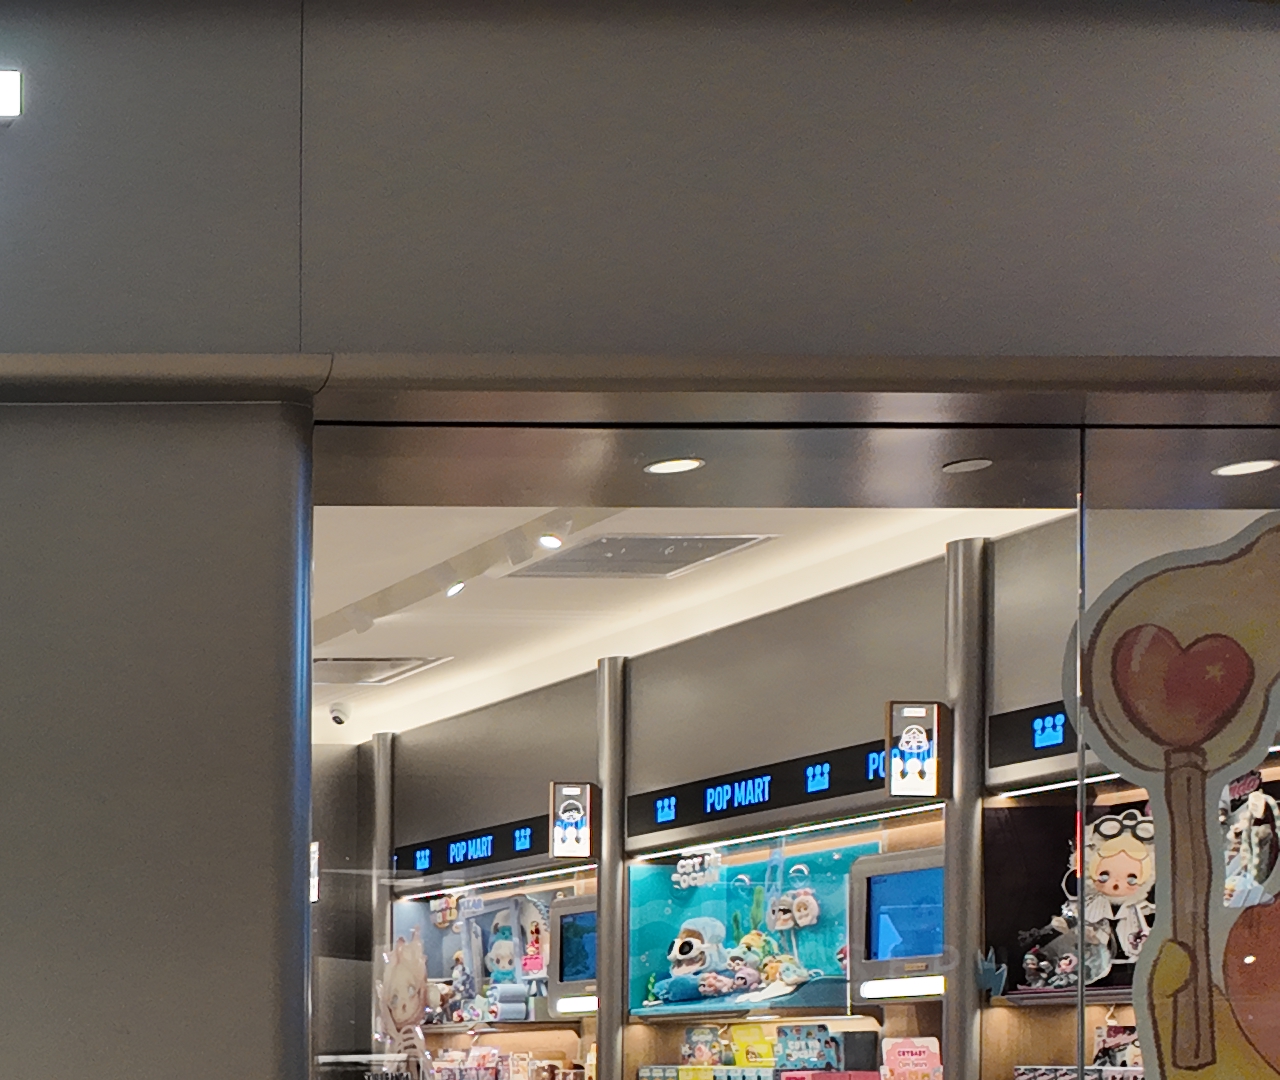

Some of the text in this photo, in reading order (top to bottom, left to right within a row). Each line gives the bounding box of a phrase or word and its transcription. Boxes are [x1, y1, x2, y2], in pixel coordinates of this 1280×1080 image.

[706, 775, 771, 813] POP MART
[449, 835, 494, 864] POP MART
